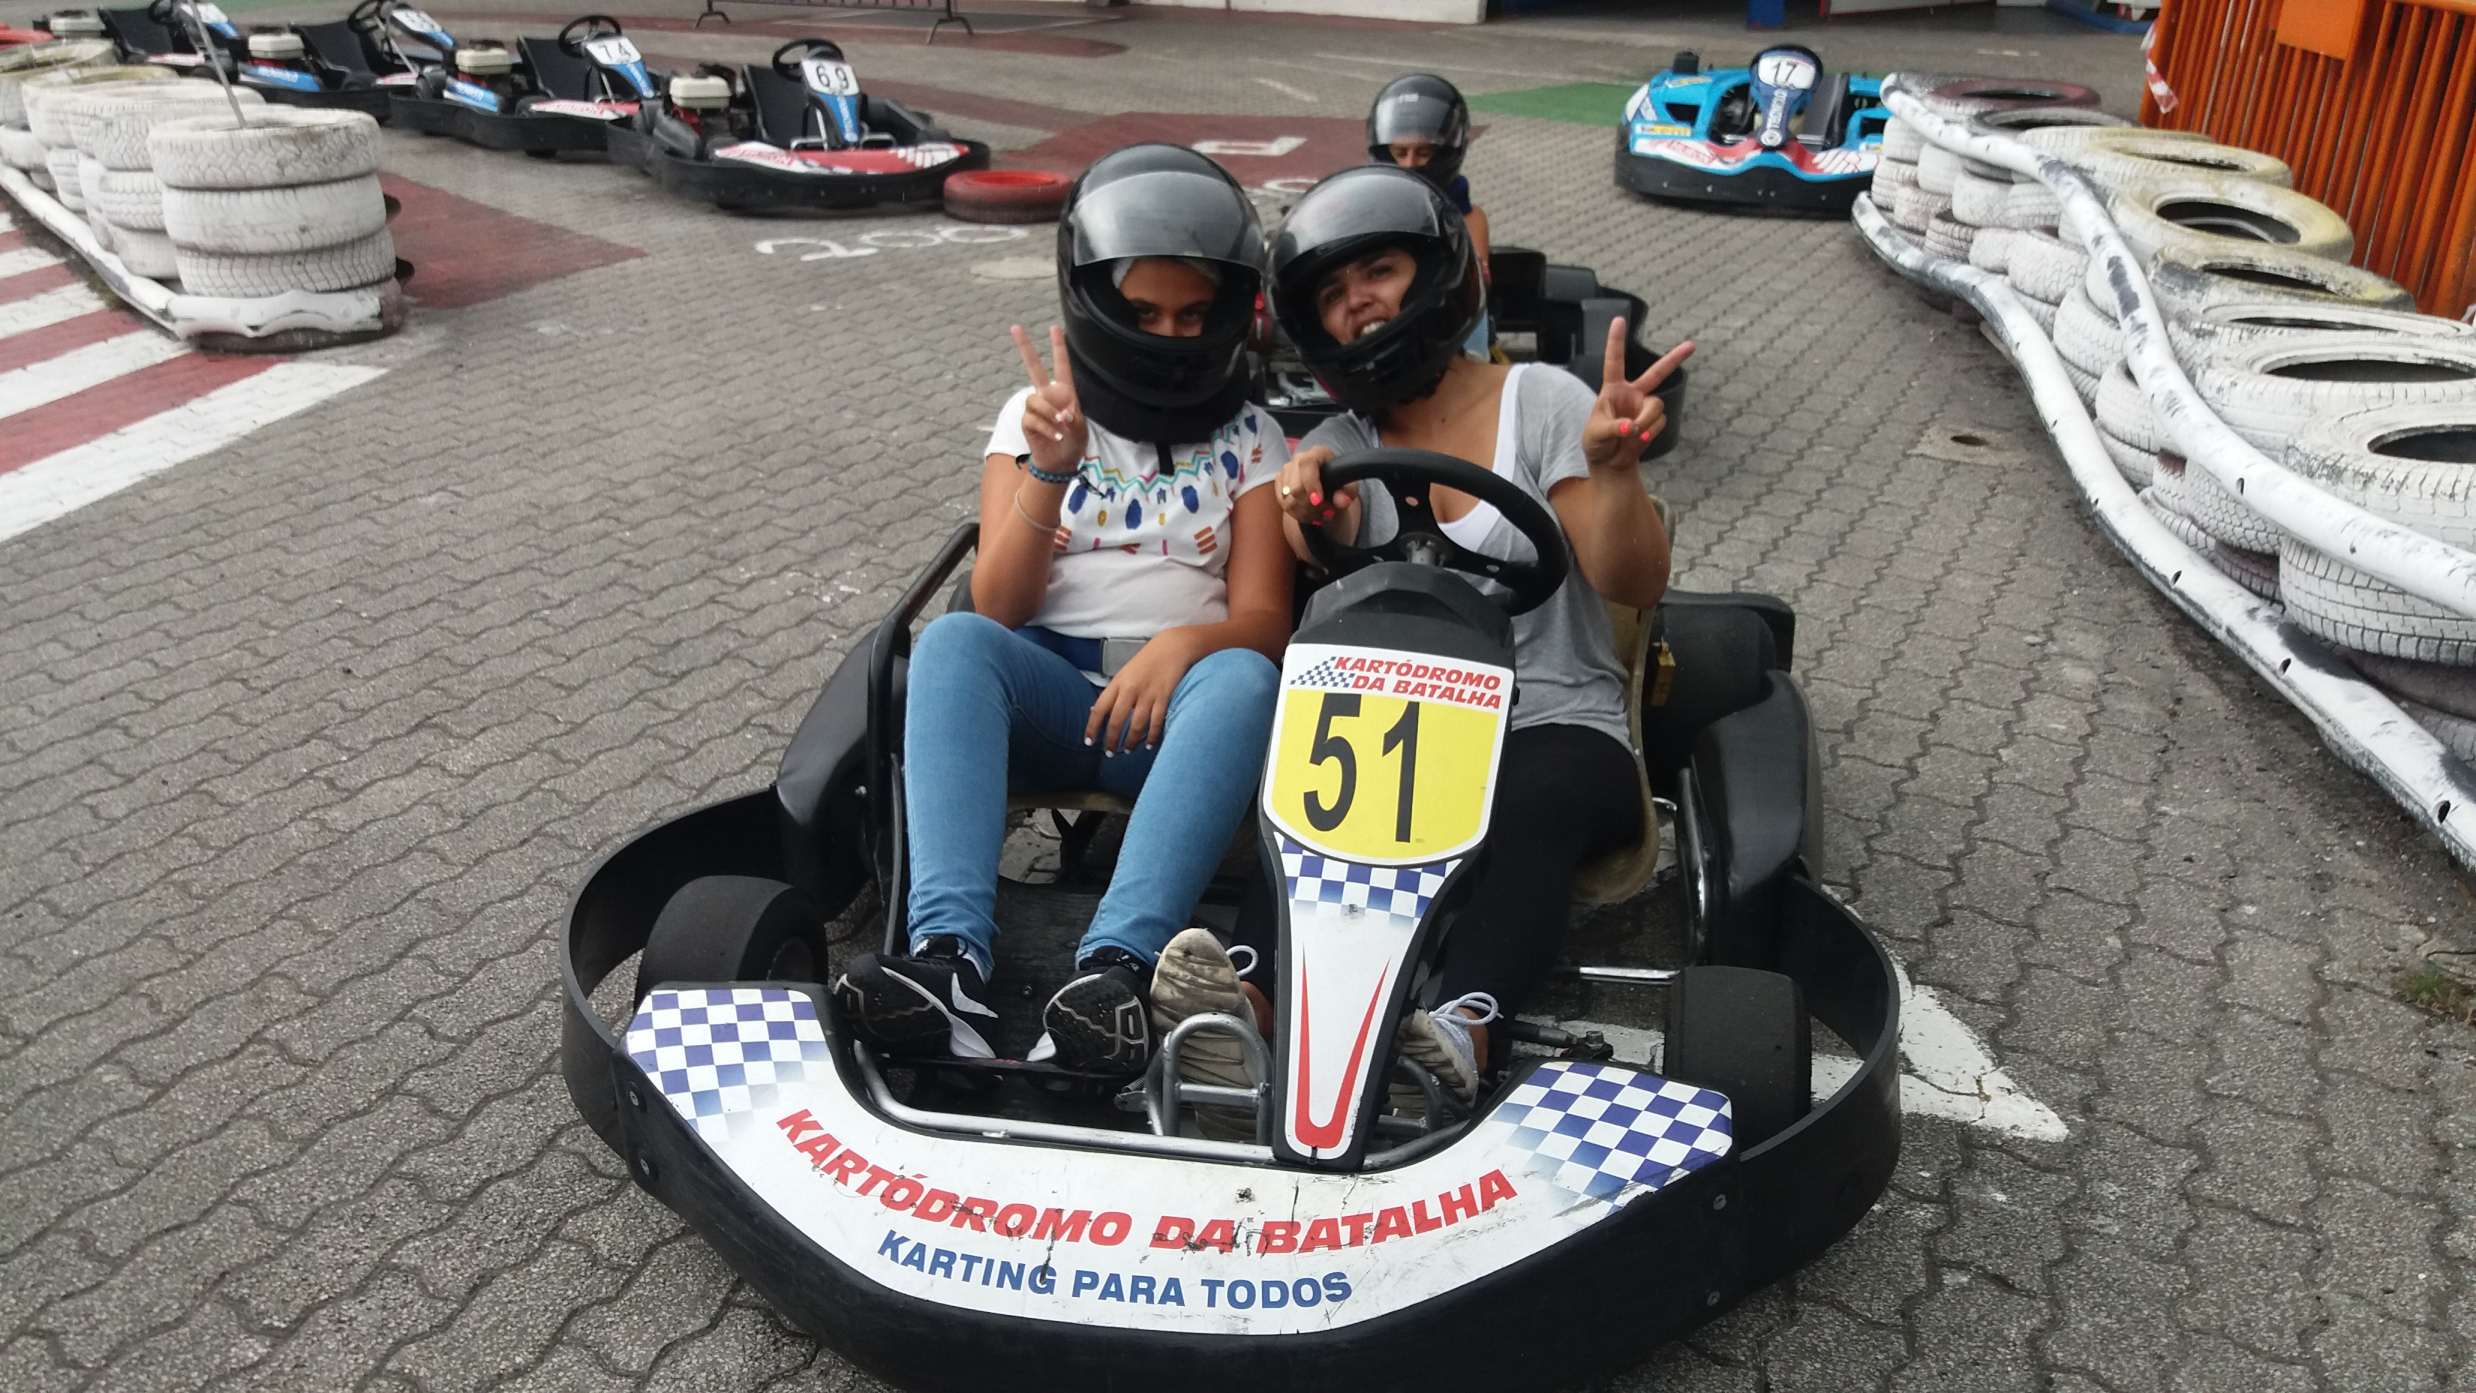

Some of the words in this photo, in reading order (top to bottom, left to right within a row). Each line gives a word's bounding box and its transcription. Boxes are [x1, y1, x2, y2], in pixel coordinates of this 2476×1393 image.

[815, 63, 849, 90] 69
[1772, 61, 1799, 83] 17
[1334, 655, 1502, 690] KARTÓDROMO
[1351, 675, 1386, 691] DA
[1393, 680, 1502, 709] BATALHA
[1303, 692, 1421, 844] 51
[776, 1108, 1133, 1246] KARTÓDROMO
[1149, 1214, 1235, 1253] DA
[1256, 1168, 1518, 1254] BATALHA
[878, 1229, 1057, 1296] KARTING
[1072, 1270, 1186, 1307] PARA
[1200, 1271, 1353, 1310] TODOS
